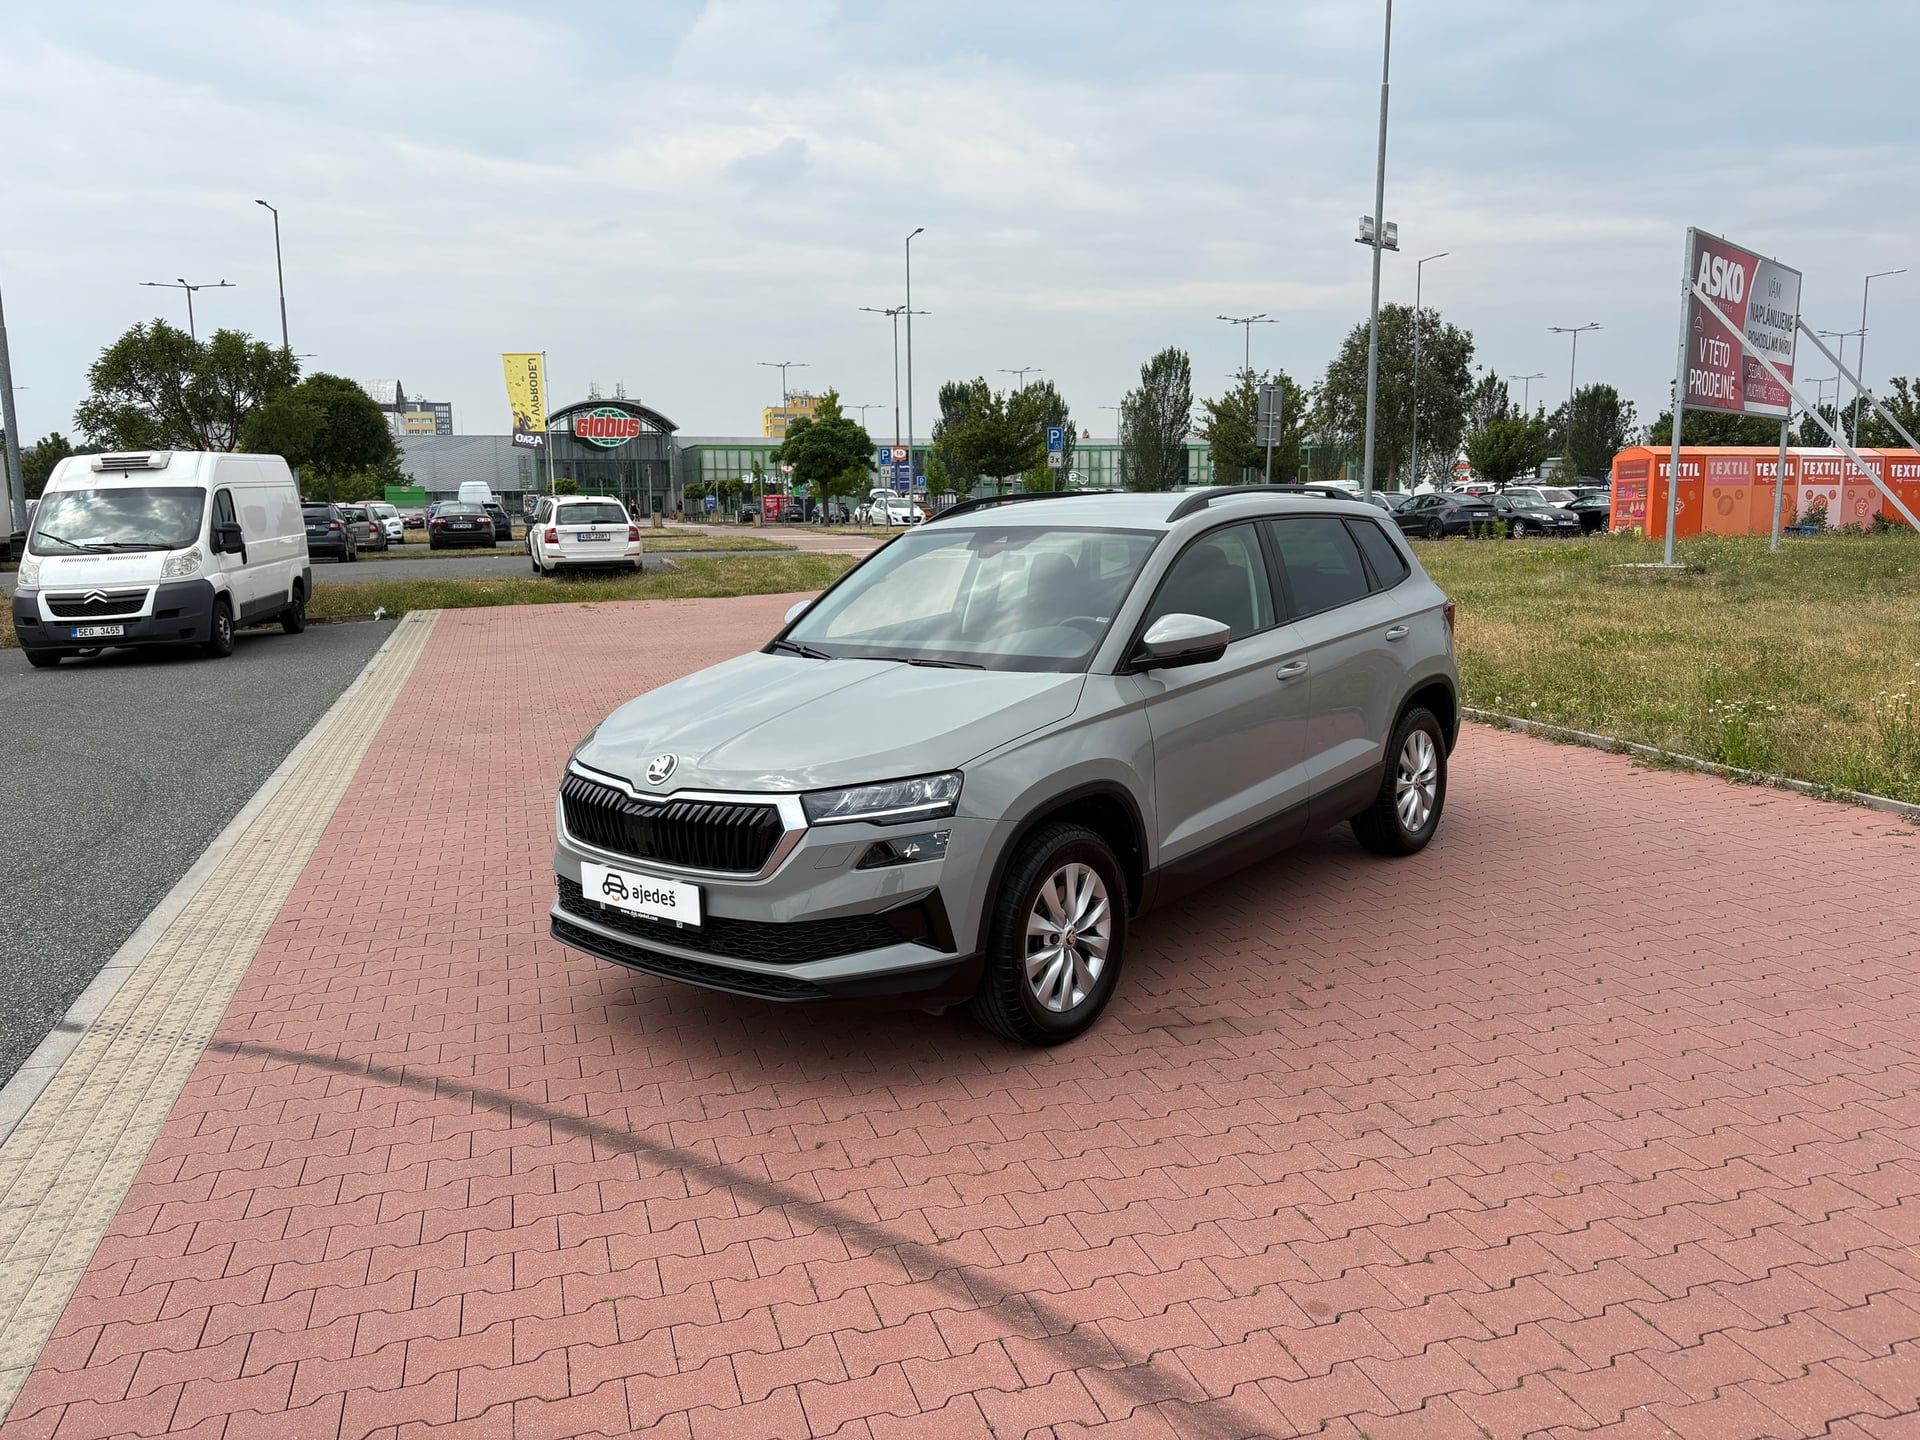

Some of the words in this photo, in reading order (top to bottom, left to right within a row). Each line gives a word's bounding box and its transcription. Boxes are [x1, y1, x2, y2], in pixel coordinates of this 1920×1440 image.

[1697, 251, 1745, 304] ASKO
[1750, 302, 1794, 332] NAPLÁNUJEME
[1700, 336, 1708, 363] V
[1709, 335, 1731, 368] TÉTO
[1689, 368, 1736, 400] PRODEJNĚ
[1049, 456, 1060, 464] 3x
[1709, 461, 1749, 475] TEXTIL
[1803, 462, 1840, 475] TEXTIL
[1756, 463, 1795, 476] TEXIL
[1891, 464, 1920, 477] TEXTI
[632, 884, 676, 907] ajedeš
